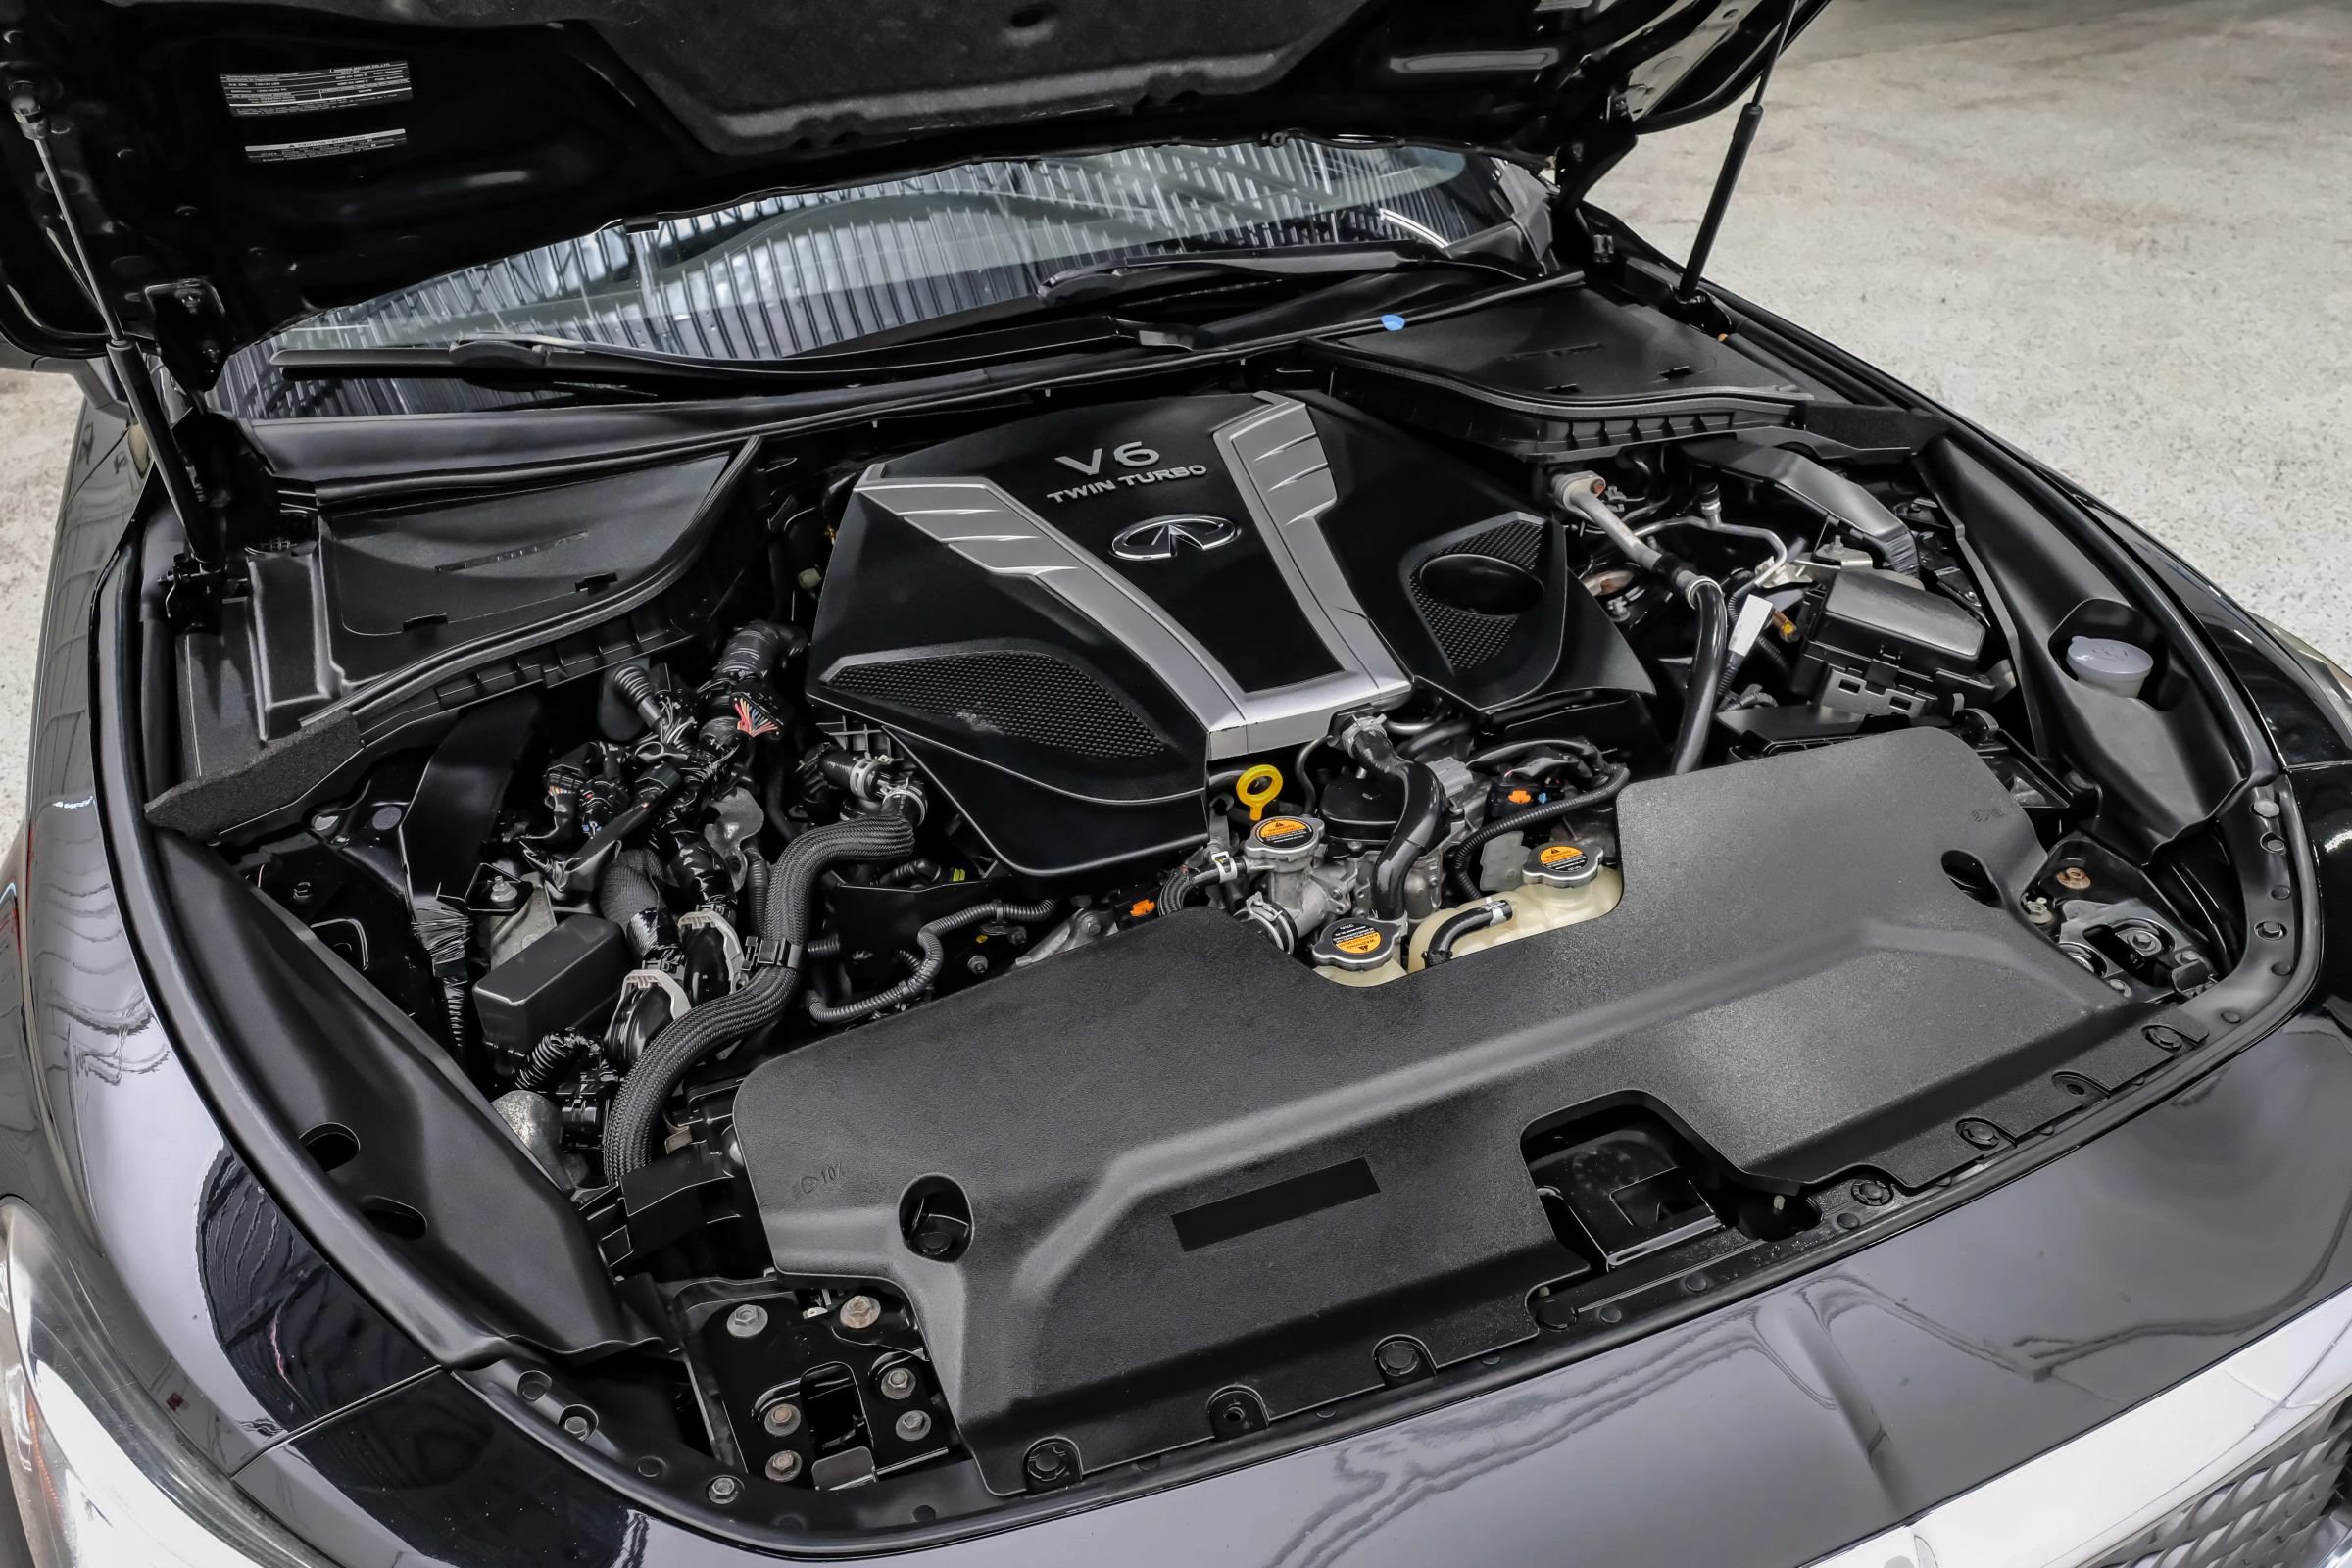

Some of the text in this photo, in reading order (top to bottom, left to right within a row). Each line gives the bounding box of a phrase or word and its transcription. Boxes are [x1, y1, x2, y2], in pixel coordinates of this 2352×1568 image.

[1054, 441, 1160, 476] V6
[1046, 464, 1207, 503] TWIN TURBO
